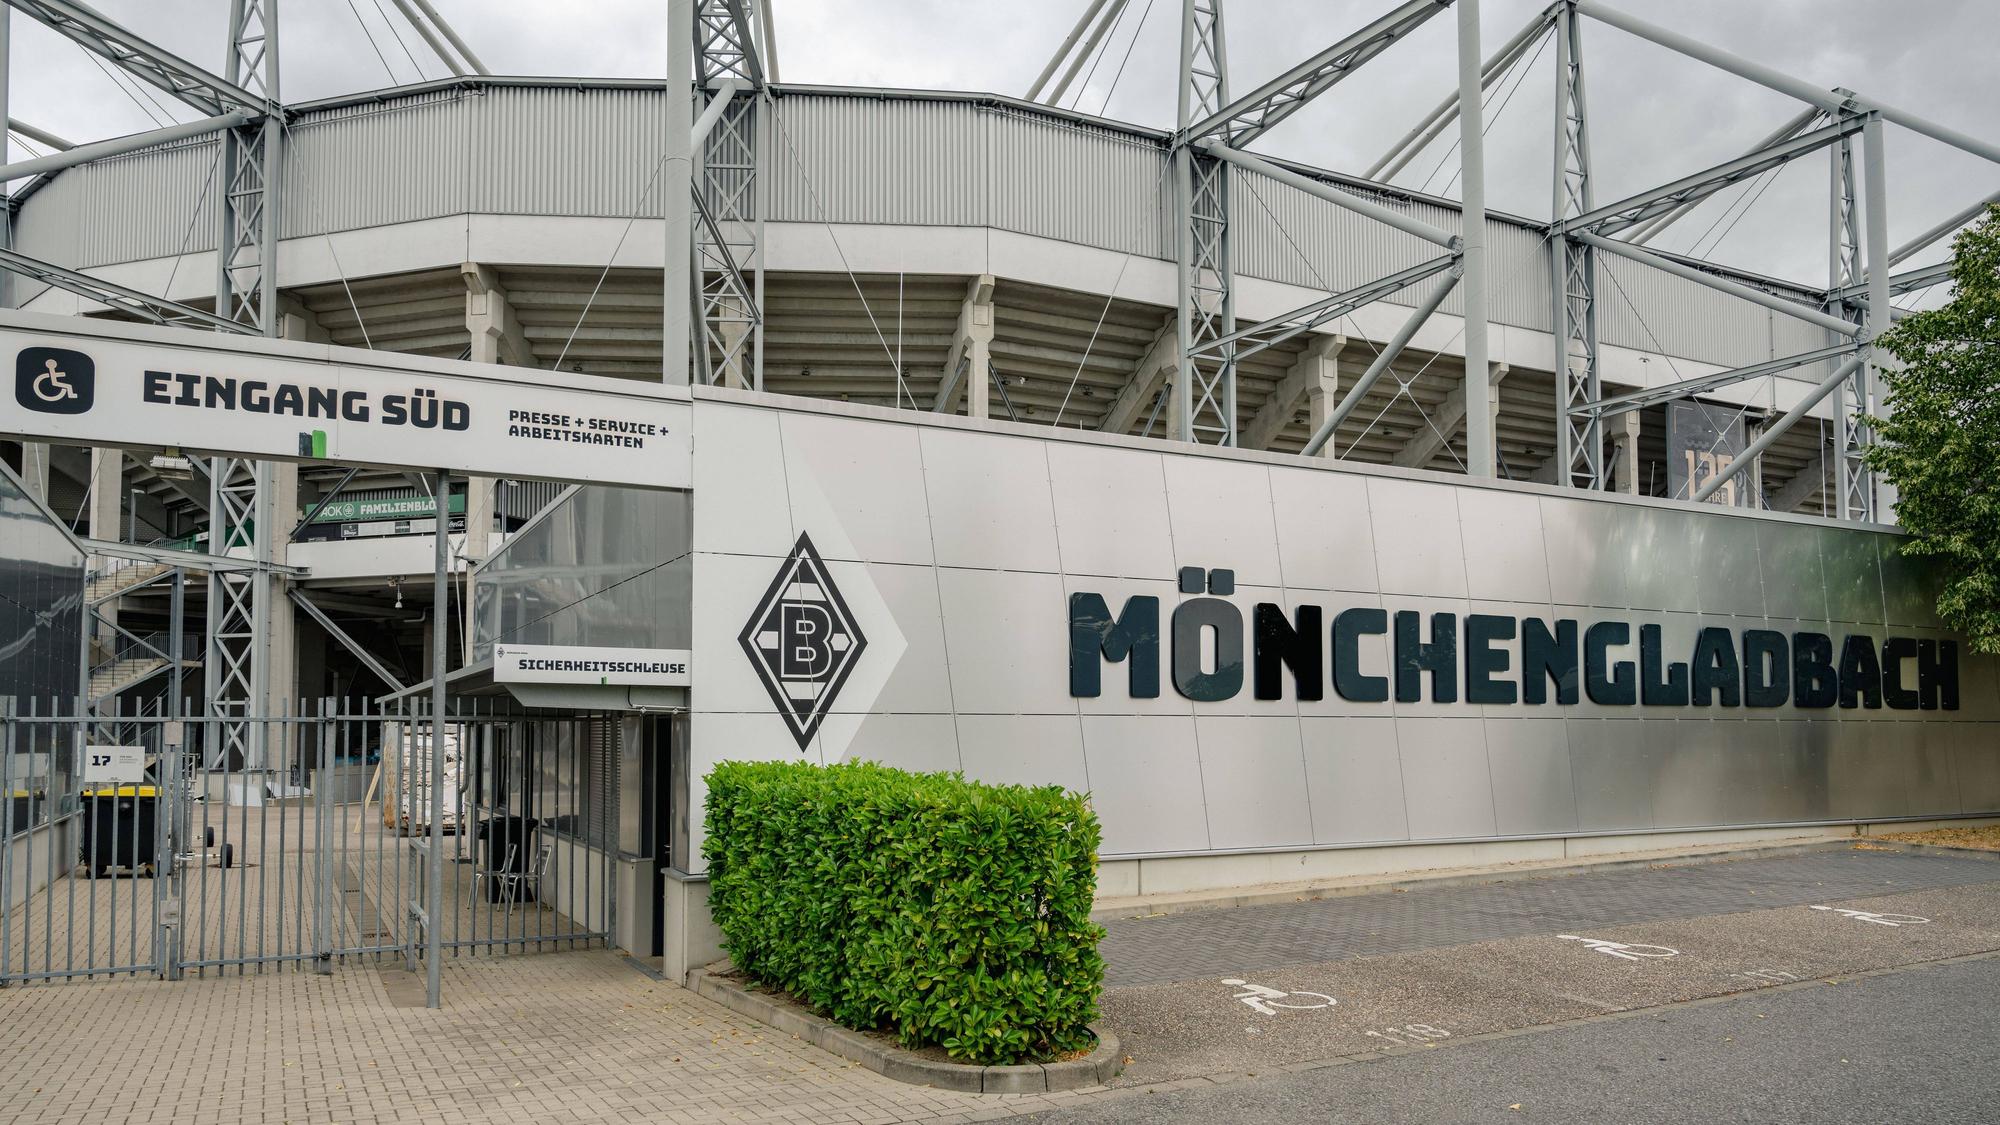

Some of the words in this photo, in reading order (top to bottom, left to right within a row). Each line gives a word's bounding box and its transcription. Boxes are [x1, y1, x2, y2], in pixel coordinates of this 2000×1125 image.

[143, 370, 370, 422] EINGANG
[382, 388, 470, 431] SÜD
[509, 409, 570, 427] PRESSE
[574, 418, 584, 427] +
[588, 418, 656, 436] SERVICE
[659, 427, 669, 436] +
[508, 425, 644, 449] ARBEITSKARTEN
[320, 505, 343, 517] AOK
[780, 602, 833, 678] B
[1069, 566, 1960, 711] MÖNCHENGLADBACH
[518, 659, 686, 674] SICHERHEITSSCHLEUSE
[92, 755, 111, 766] 17
[1365, 1023, 1450, 1045] 118
